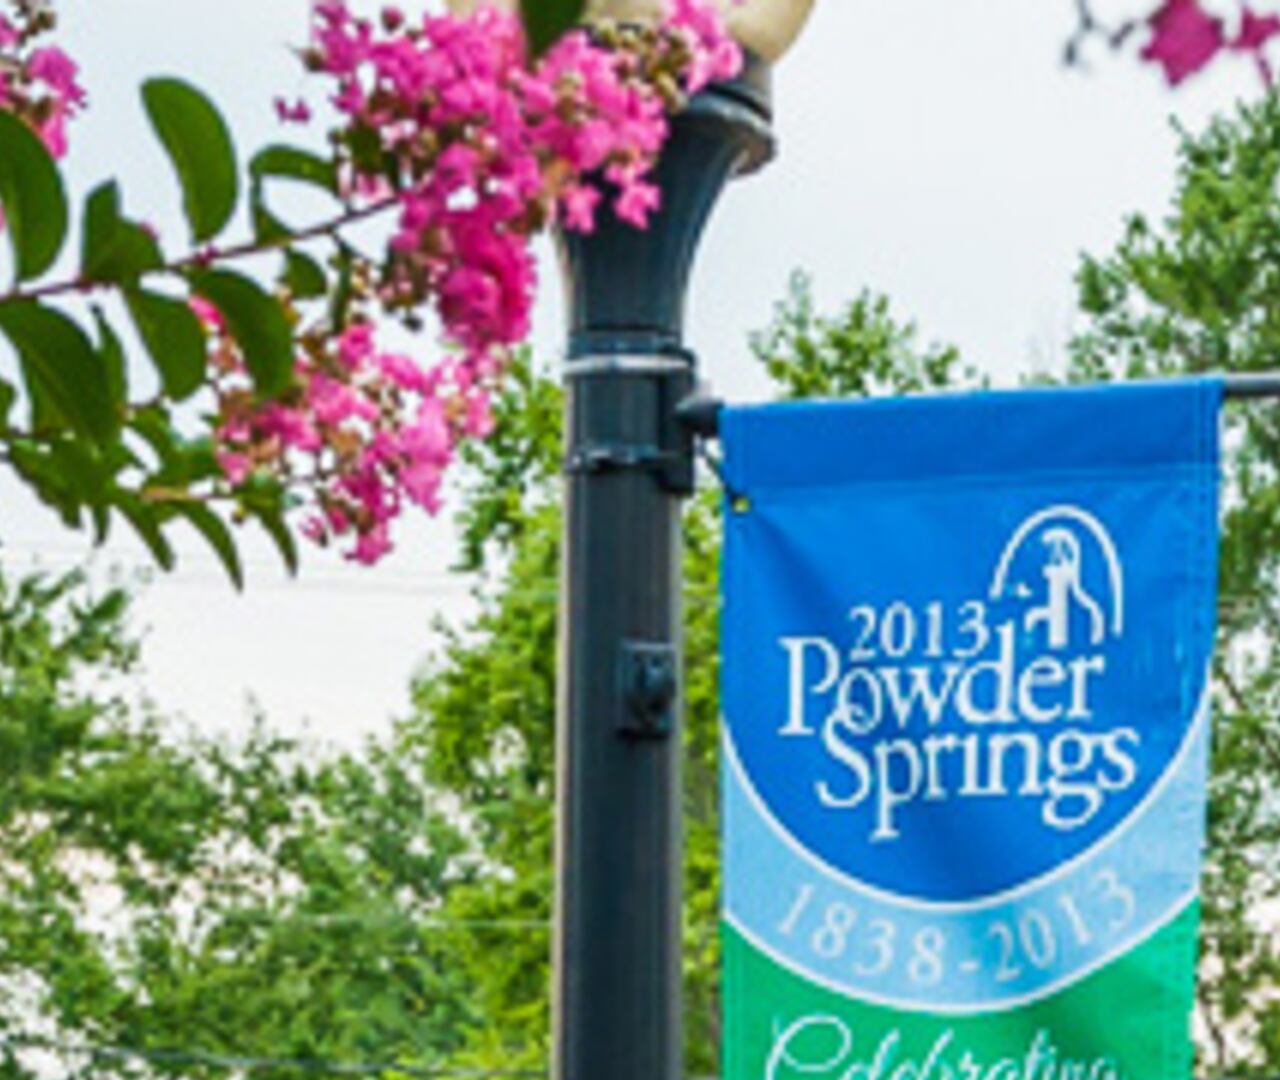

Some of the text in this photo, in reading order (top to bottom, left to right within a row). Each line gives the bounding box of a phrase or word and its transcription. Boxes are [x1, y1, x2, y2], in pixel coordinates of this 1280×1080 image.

[776, 618, 1105, 736] Powder
[849, 599, 989, 661] 2013
[815, 707, 1141, 842] Springs
[775, 866, 1136, 985] 1838-2013
